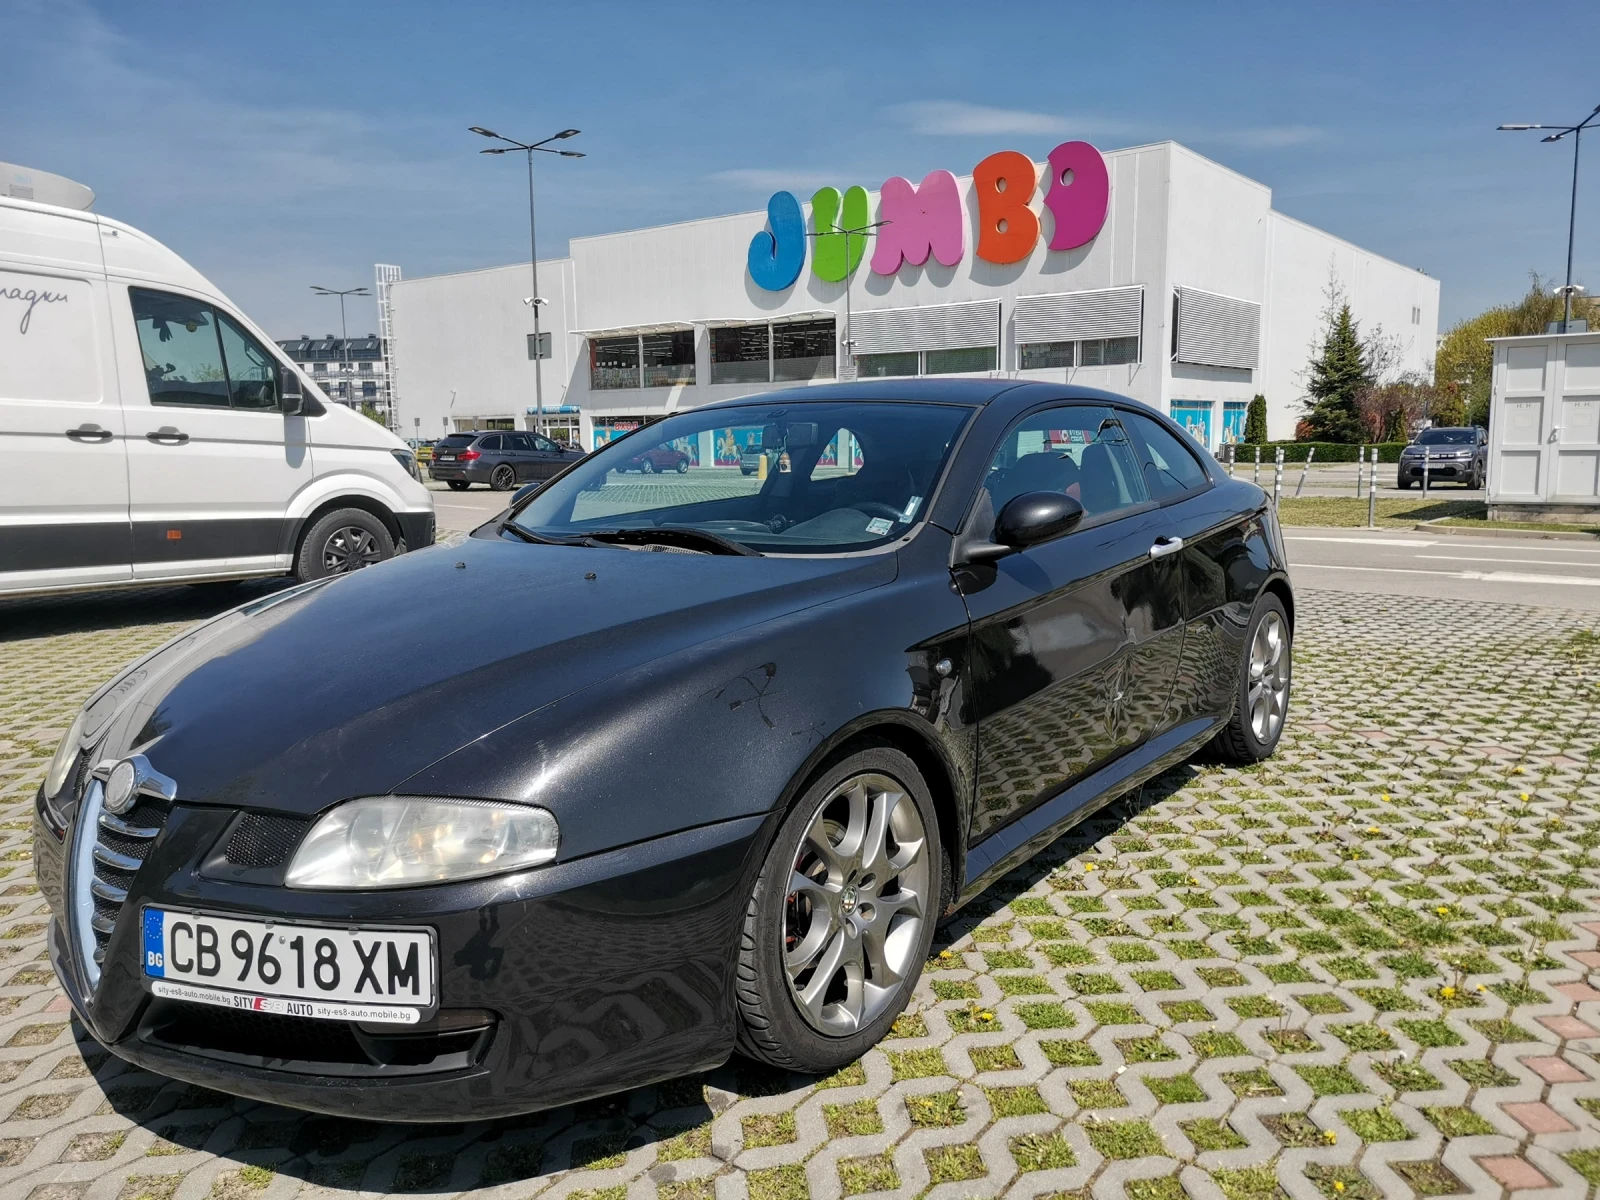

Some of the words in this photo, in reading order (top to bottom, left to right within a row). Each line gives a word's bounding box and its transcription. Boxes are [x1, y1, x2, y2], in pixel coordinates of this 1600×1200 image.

[748, 140, 1110, 292] JUMBO
[147, 951, 163, 968] BG
[170, 921, 221, 977] CB
[231, 929, 341, 991] 9618
[352, 940, 420, 996] XM
[158, 986, 231, 1005] sity-es8-auto.mobile.bg
[234, 995, 254, 1009] SITY
[287, 1002, 313, 1016] AUTO
[317, 1006, 411, 1021] sity-es8-auto.mobile.bg
